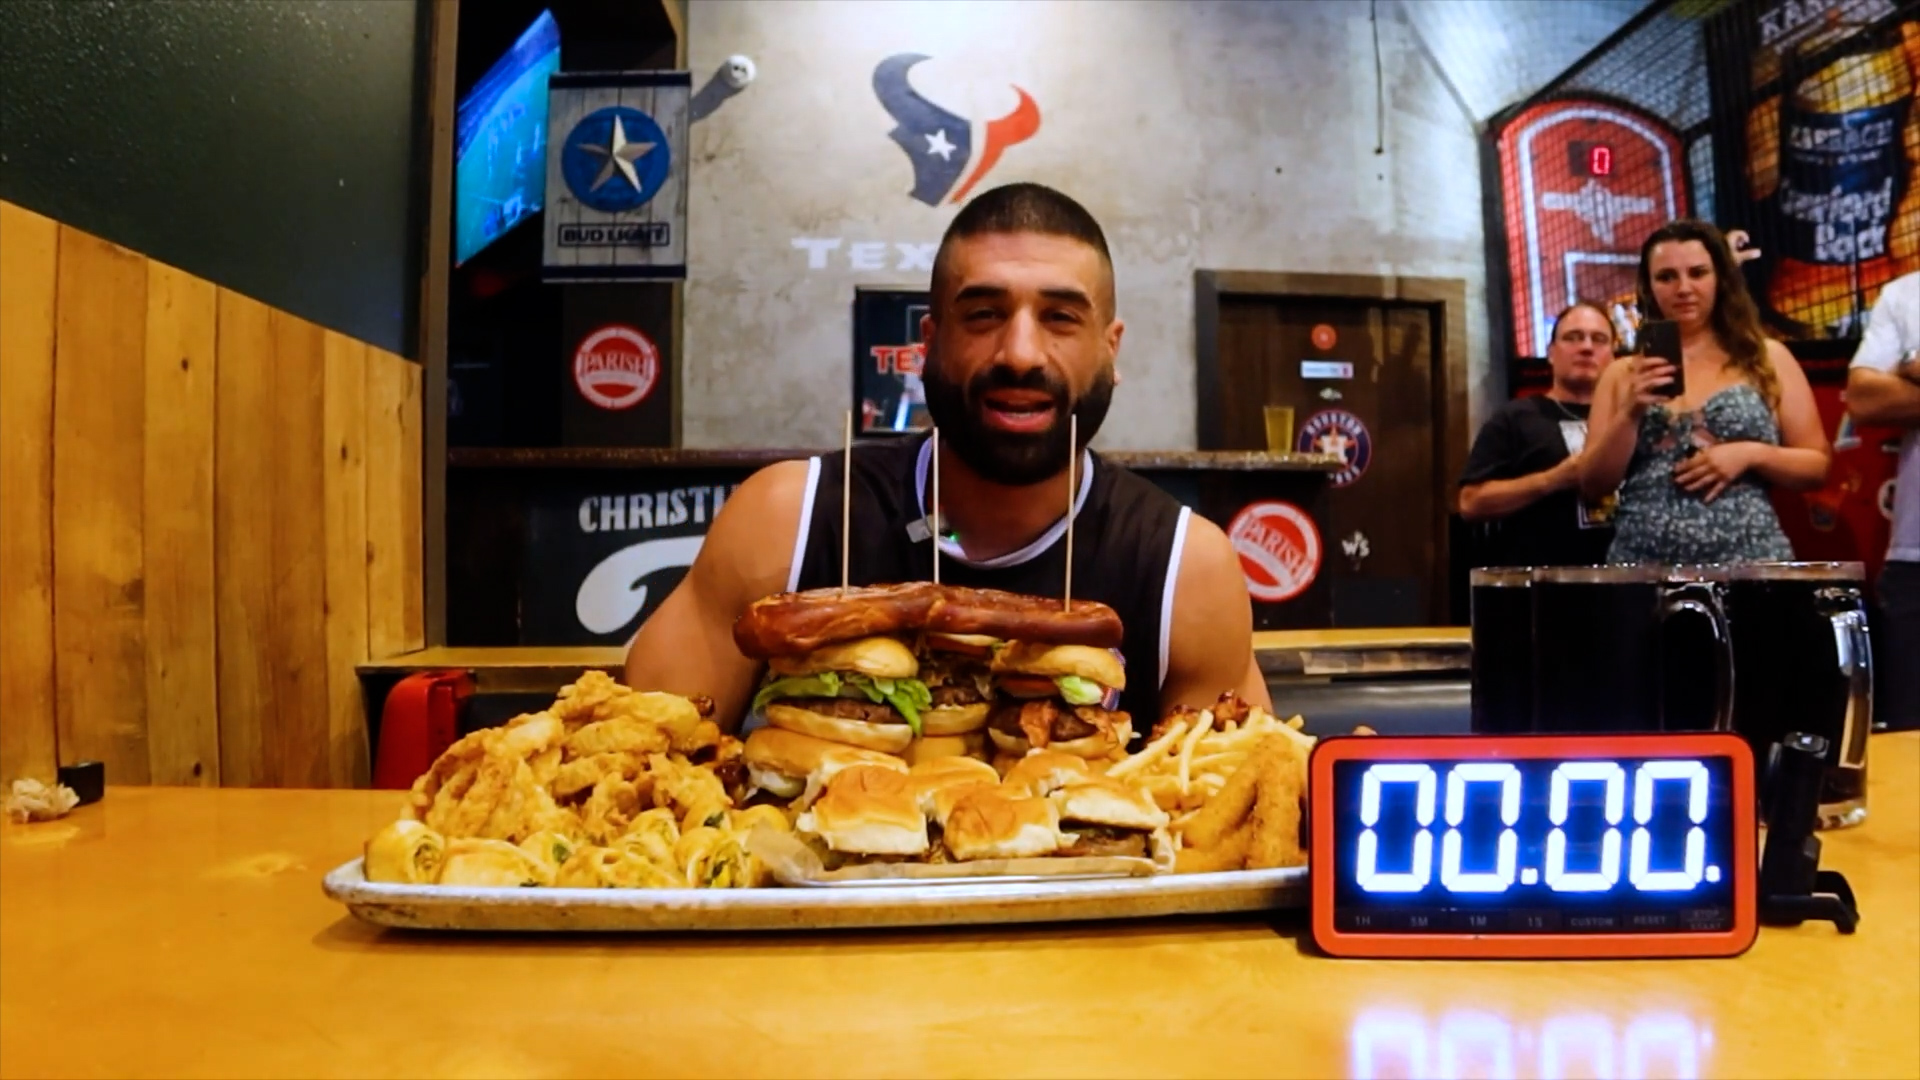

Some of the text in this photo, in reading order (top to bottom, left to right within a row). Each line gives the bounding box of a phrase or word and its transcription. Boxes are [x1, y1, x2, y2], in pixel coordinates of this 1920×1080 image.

[1592, 147, 1610, 174] 0
[564, 229, 604, 242] BUD
[584, 351, 647, 377] PARISH
[578, 484, 742, 533] CHRISTI
[1241, 517, 1308, 579] PARISH
[1355, 915, 1371, 926] 1H
[1470, 915, 1487, 926] 1M
[1570, 917, 1614, 927] CUSTOM
[1633, 915, 1666, 925] RESET
